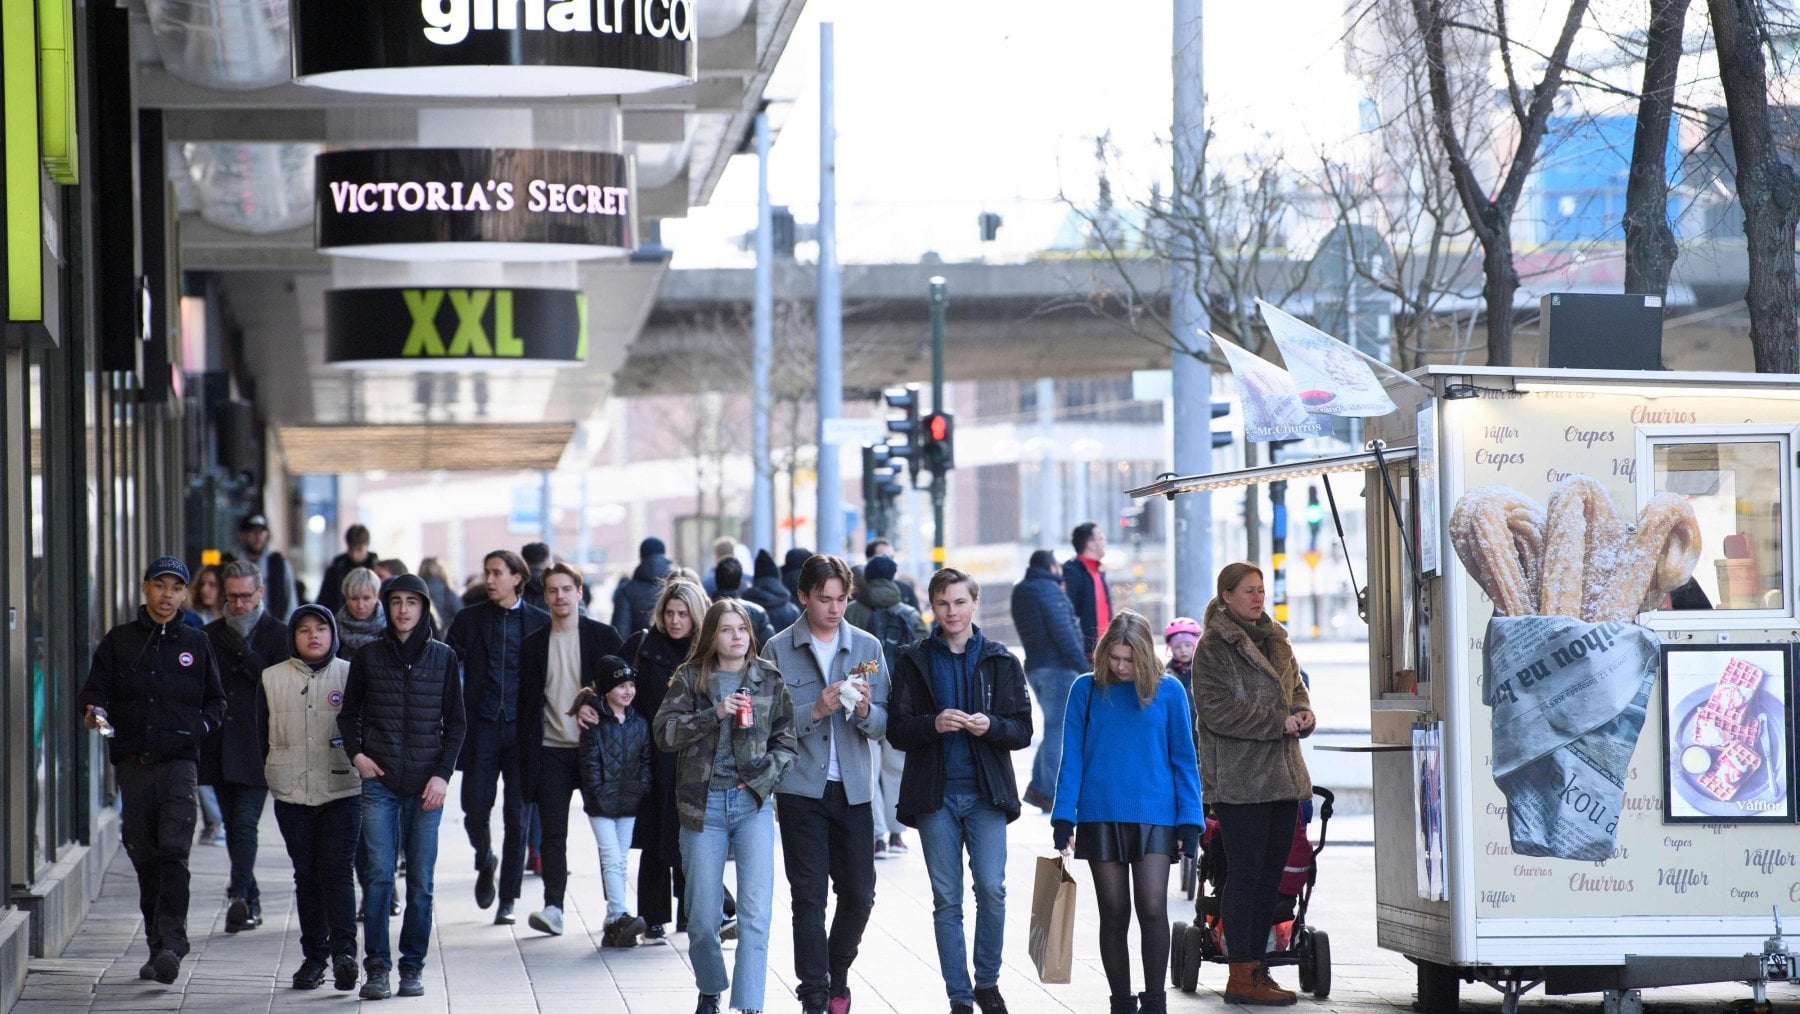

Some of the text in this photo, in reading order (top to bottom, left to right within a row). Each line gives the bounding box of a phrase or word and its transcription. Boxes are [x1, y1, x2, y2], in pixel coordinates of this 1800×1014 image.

[421, 0, 698, 46] ginatrico
[330, 180, 628, 215] VICTORIA'S SECRET
[402, 290, 524, 357] XXL
[1630, 404, 1697, 424] Churros
[1484, 424, 1519, 444] Våfflor
[1564, 425, 1615, 449] Crepes
[1475, 448, 1525, 471] Crepes
[1736, 800, 1783, 812] Våfflor
[1664, 836, 1692, 851] Crepes
[1514, 865, 1553, 877] Churros
[1744, 849, 1796, 874] Våfflor
[1569, 873, 1635, 892] Churros
[1657, 868, 1709, 893] Våfflor
[1480, 891, 1516, 908] Våfflor
[1730, 887, 1759, 902] Crepes
